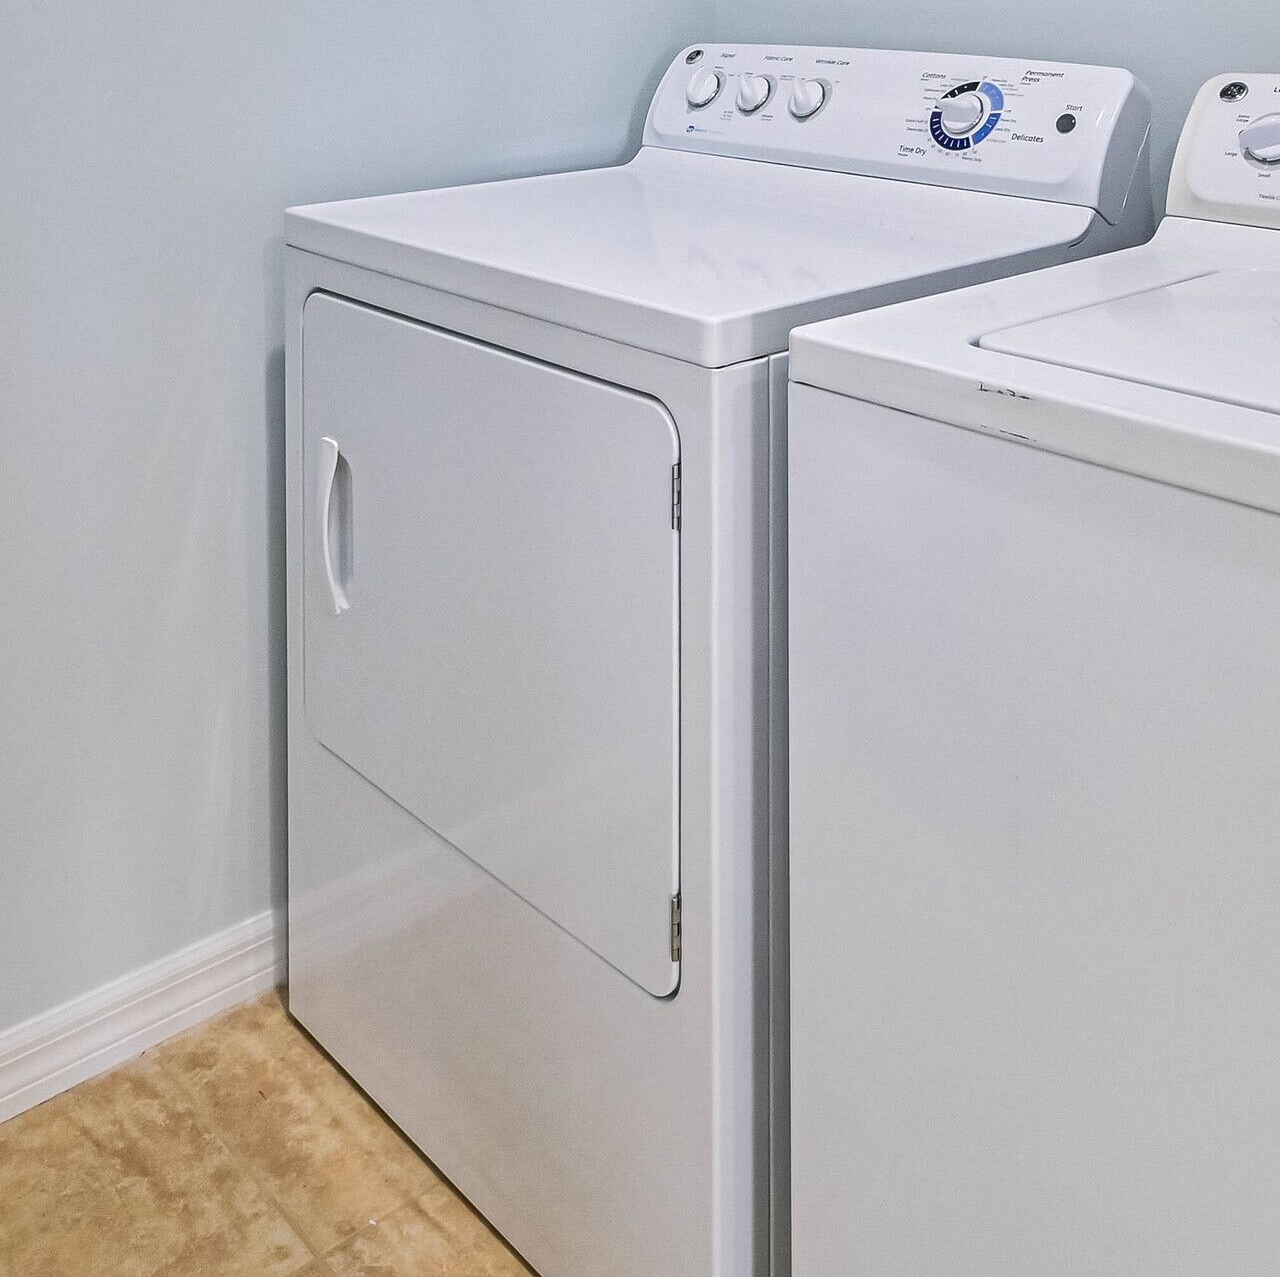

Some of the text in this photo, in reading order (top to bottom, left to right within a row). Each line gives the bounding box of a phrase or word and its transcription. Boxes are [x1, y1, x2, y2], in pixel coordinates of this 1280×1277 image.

[1025, 69, 1064, 78] Permanent
[1066, 104, 1083, 112] Start
[1011, 133, 1044, 143] Delicates
[899, 145, 913, 154] Time
[914, 147, 927, 156] Dry
